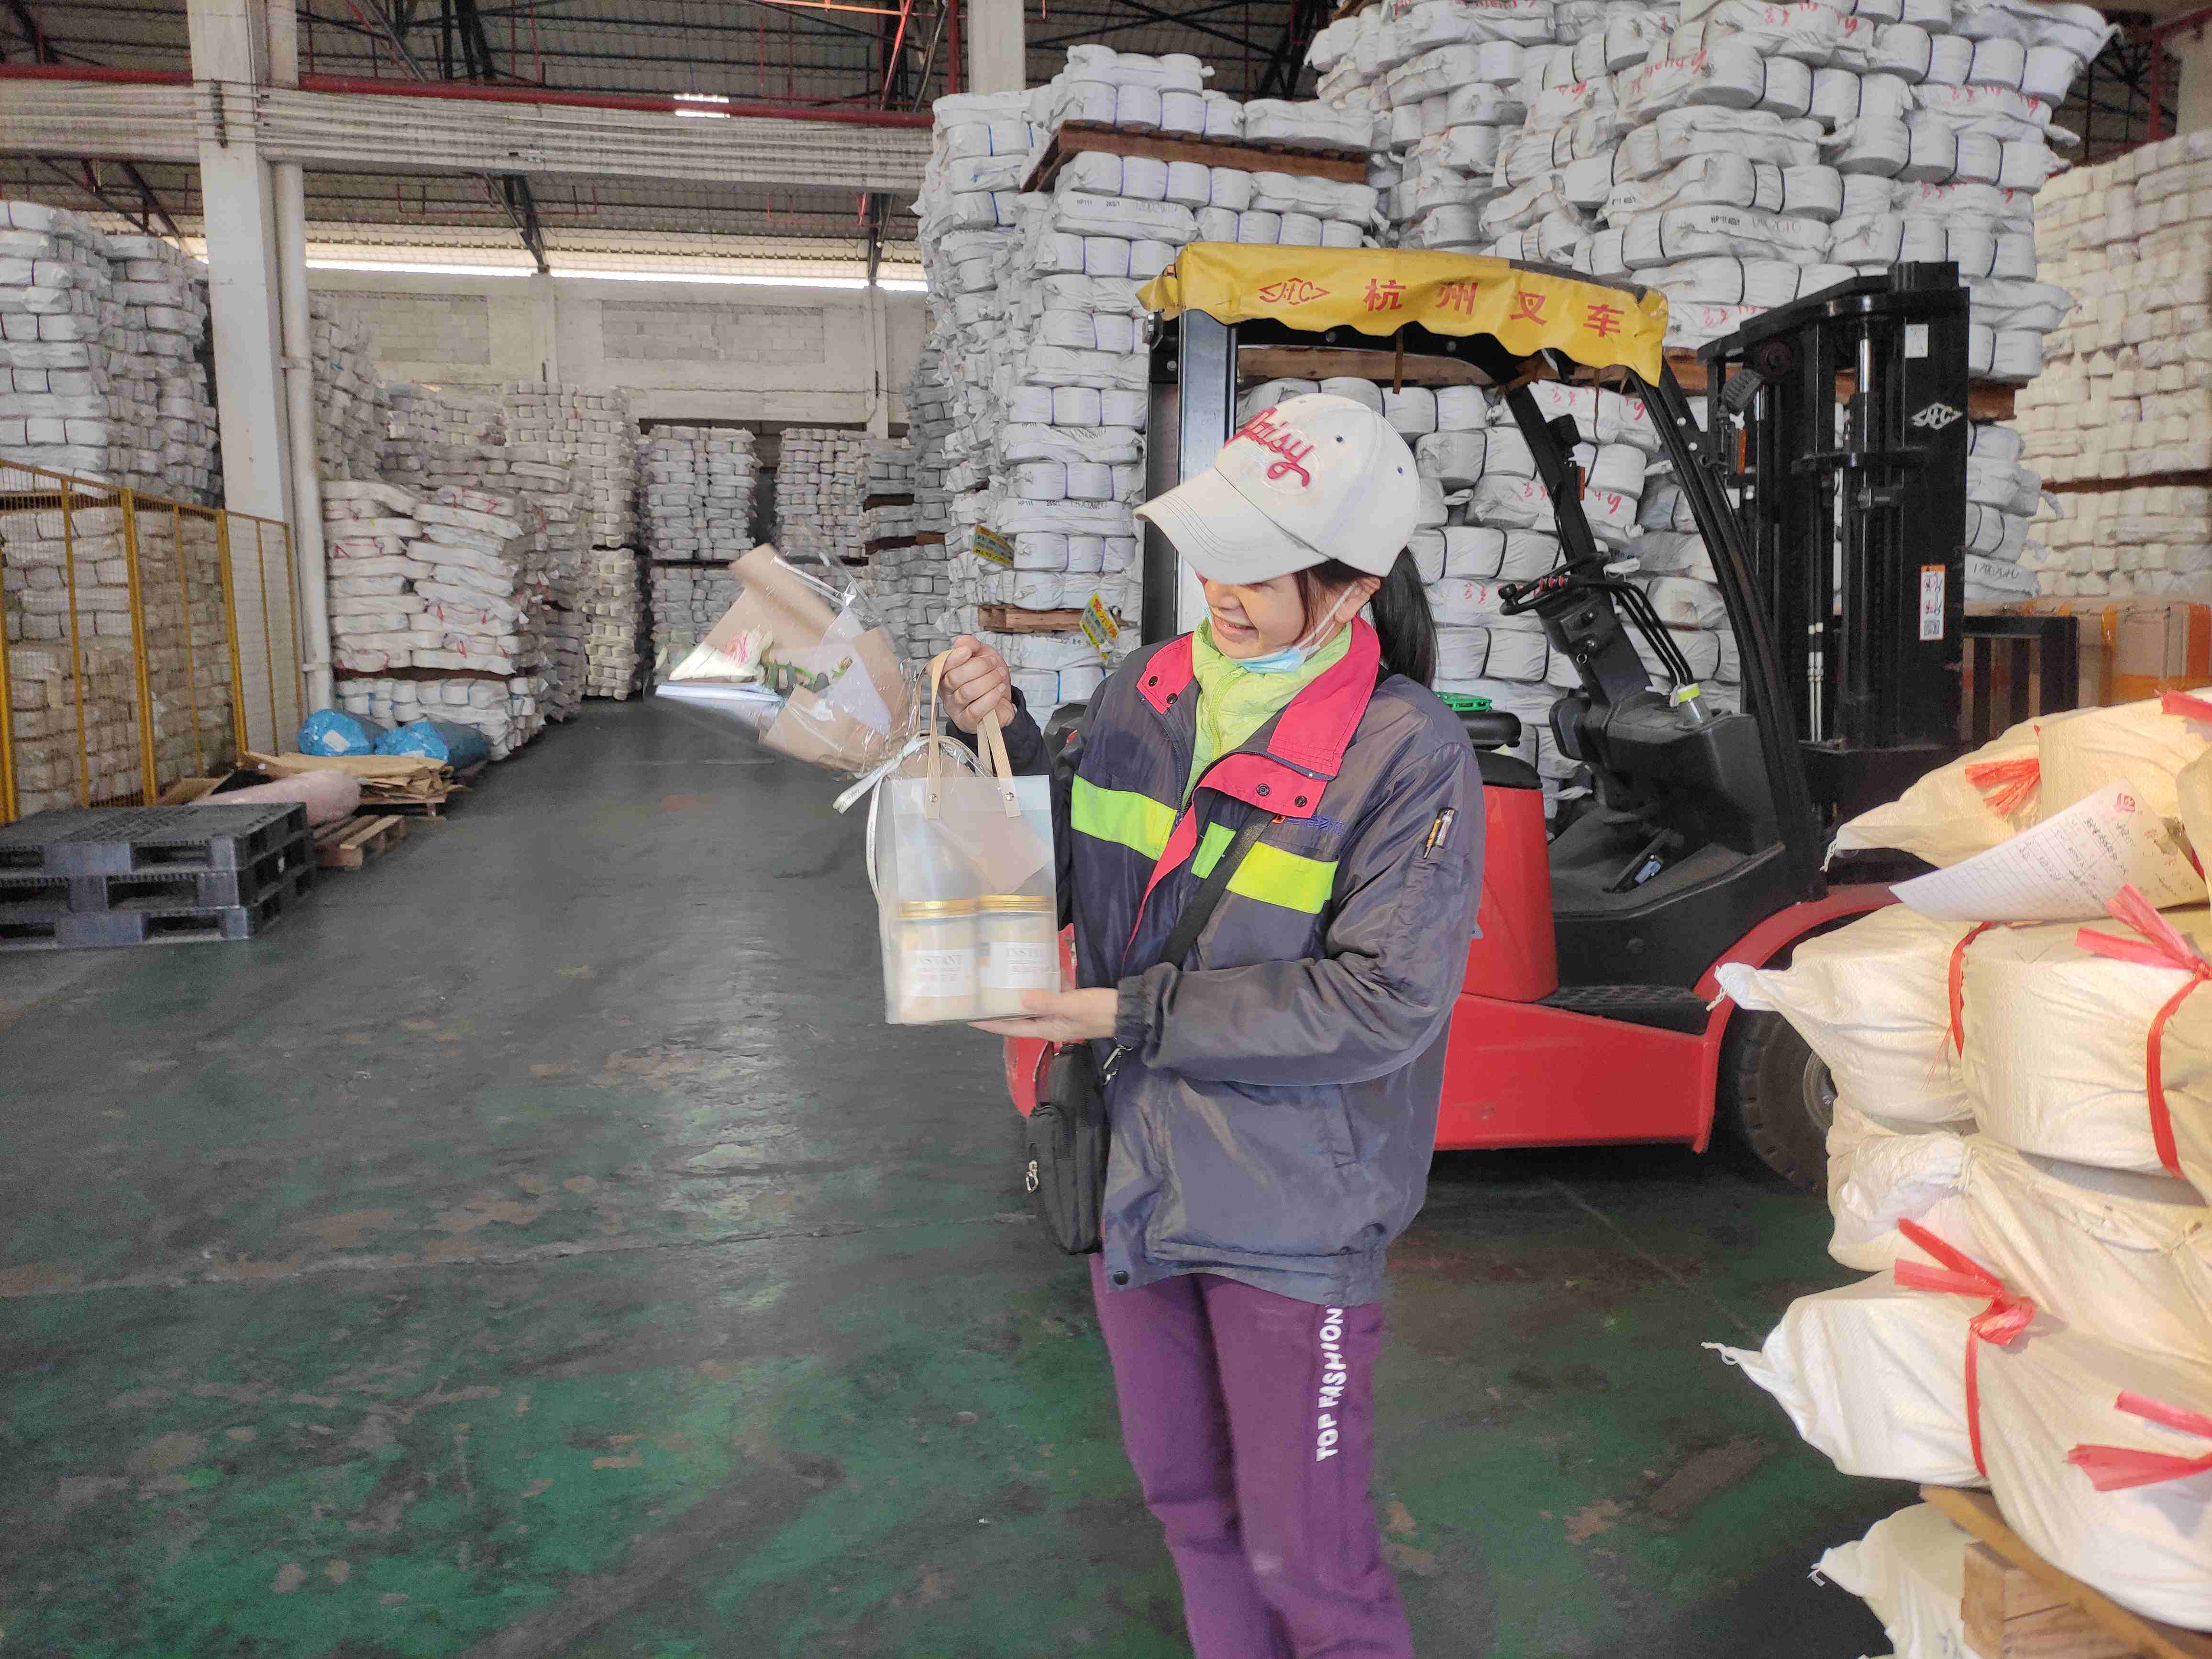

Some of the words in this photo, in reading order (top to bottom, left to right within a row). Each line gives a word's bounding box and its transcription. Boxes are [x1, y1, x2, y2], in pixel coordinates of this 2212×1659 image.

[1362, 277, 1625, 338] 杭州叉车
[1316, 1413, 1339, 1462] TOP
